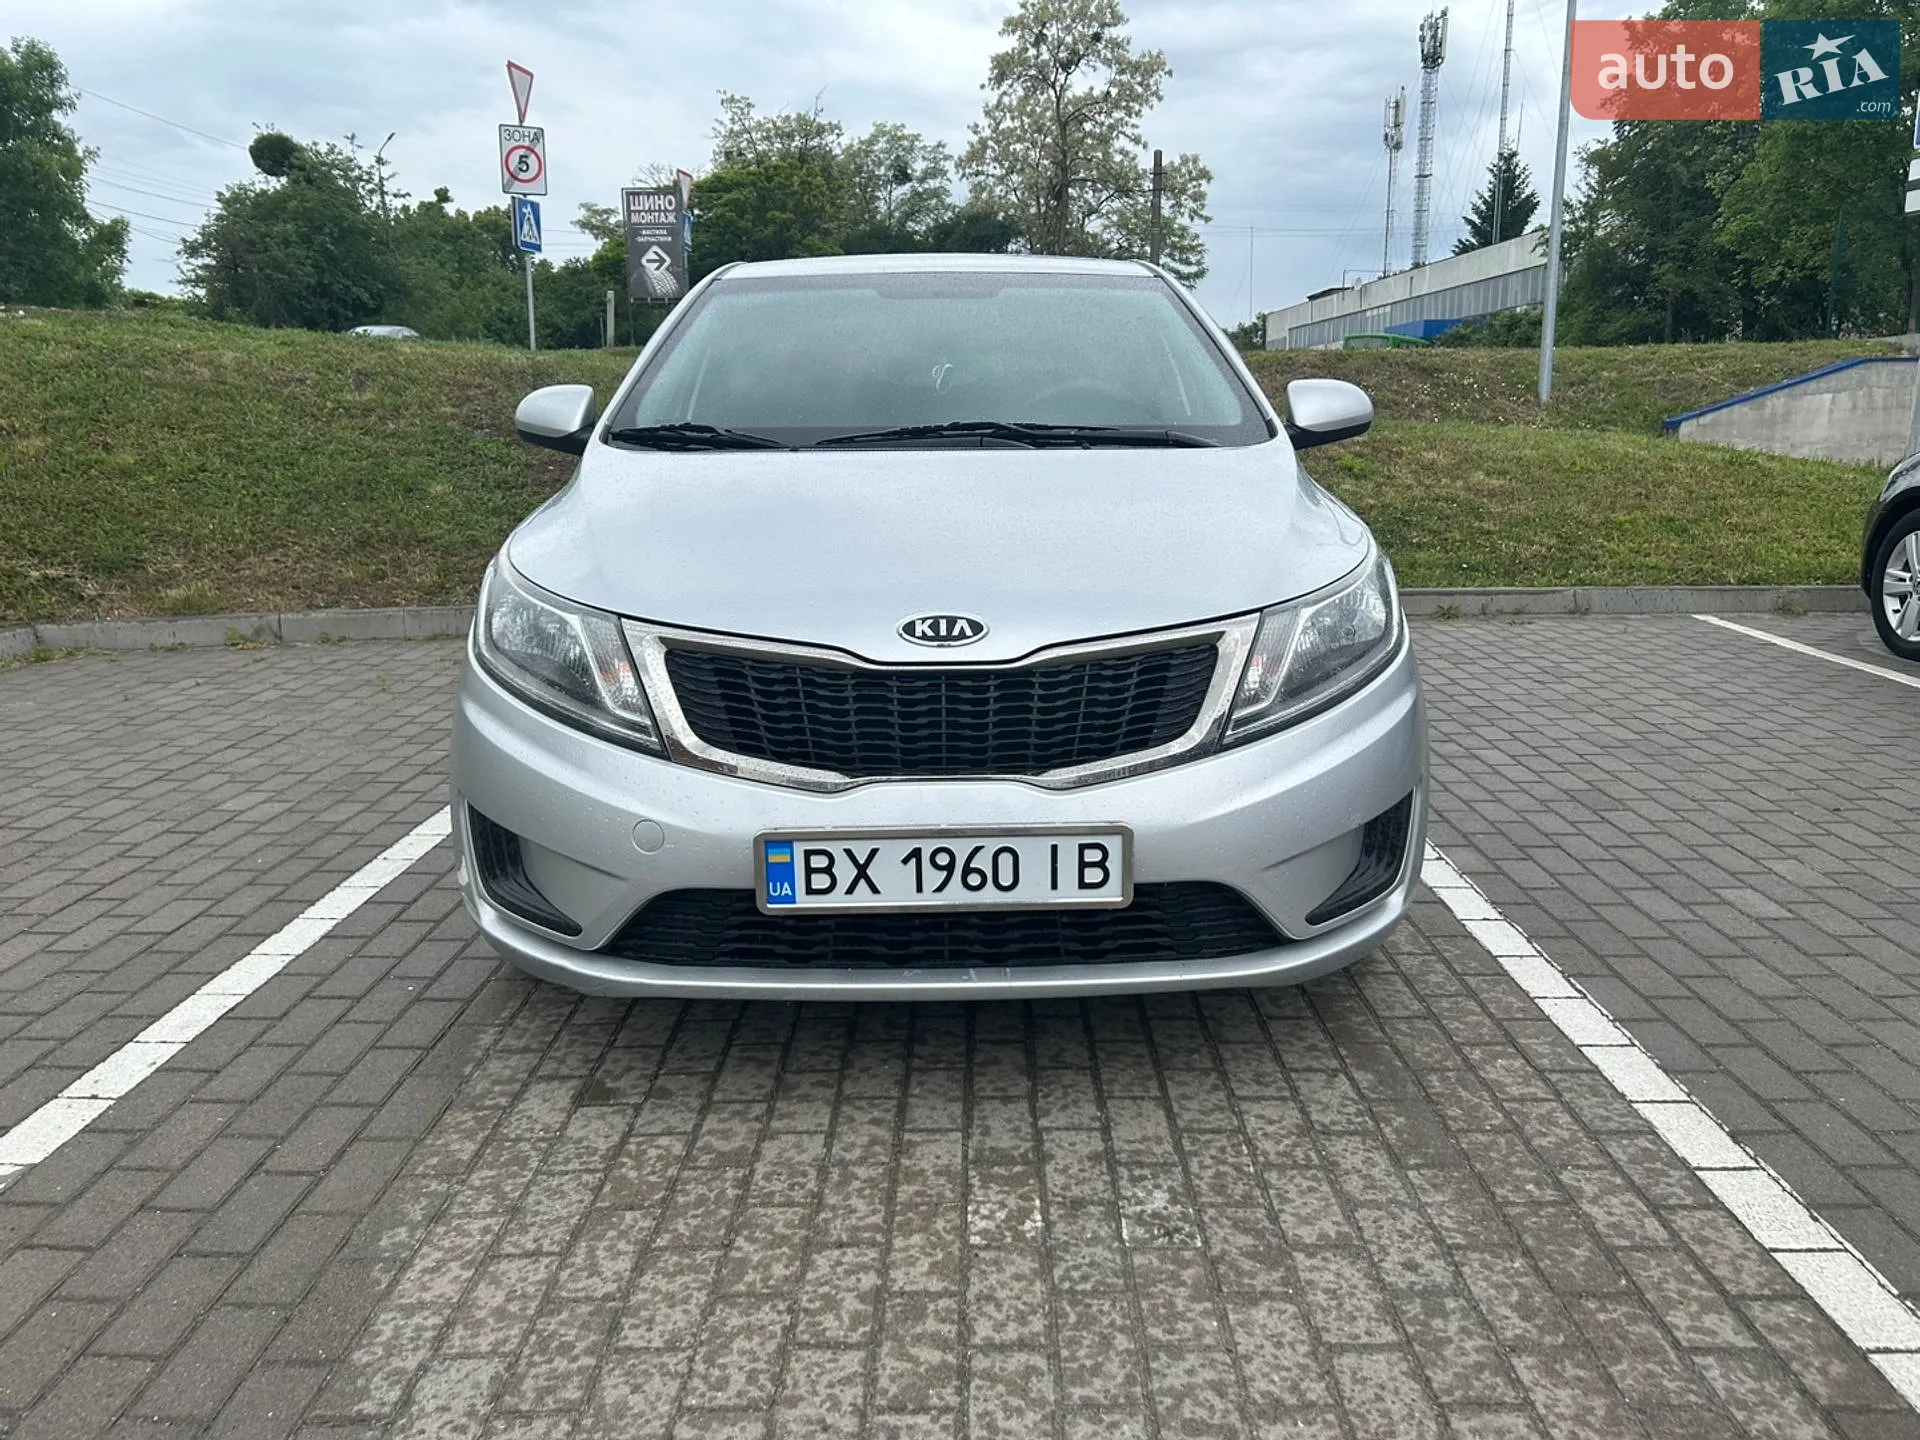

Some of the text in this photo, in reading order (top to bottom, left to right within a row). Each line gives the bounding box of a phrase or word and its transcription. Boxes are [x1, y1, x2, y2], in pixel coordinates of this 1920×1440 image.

[503, 128, 540, 143] ЗОНА
[518, 154, 530, 173] 5
[629, 194, 676, 211] ШИНО
[630, 211, 677, 224] МОНТАЖ
[914, 618, 974, 637] KIA
[803, 848, 881, 896] BX
[900, 845, 1020, 893] 1960
[769, 881, 793, 897] UA
